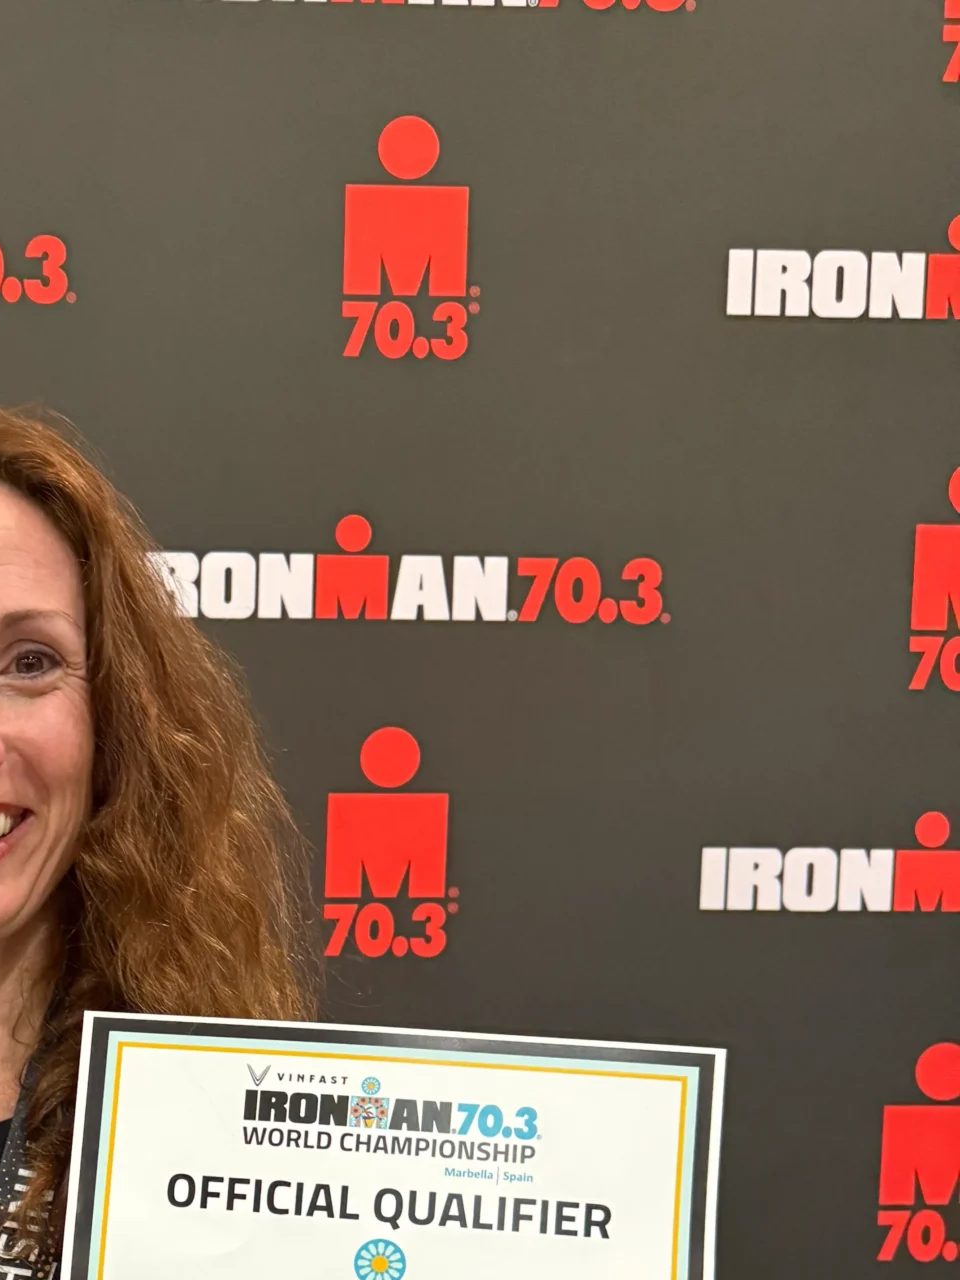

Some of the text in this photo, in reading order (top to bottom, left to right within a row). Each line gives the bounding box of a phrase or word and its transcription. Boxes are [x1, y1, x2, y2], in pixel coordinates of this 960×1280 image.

[342, 302, 468, 360] 70.3
[144, 552, 663, 624] RONMAN 70.3
[323, 904, 447, 958] 70.3
[277, 1072, 349, 1086] VINFAST
[243, 1126, 536, 1164] WORLD CHAMPIONSHIP
[444, 1167, 534, 1184] Marbella Spain
[166, 1173, 613, 1240] OFFICIAL QUALIFIER
